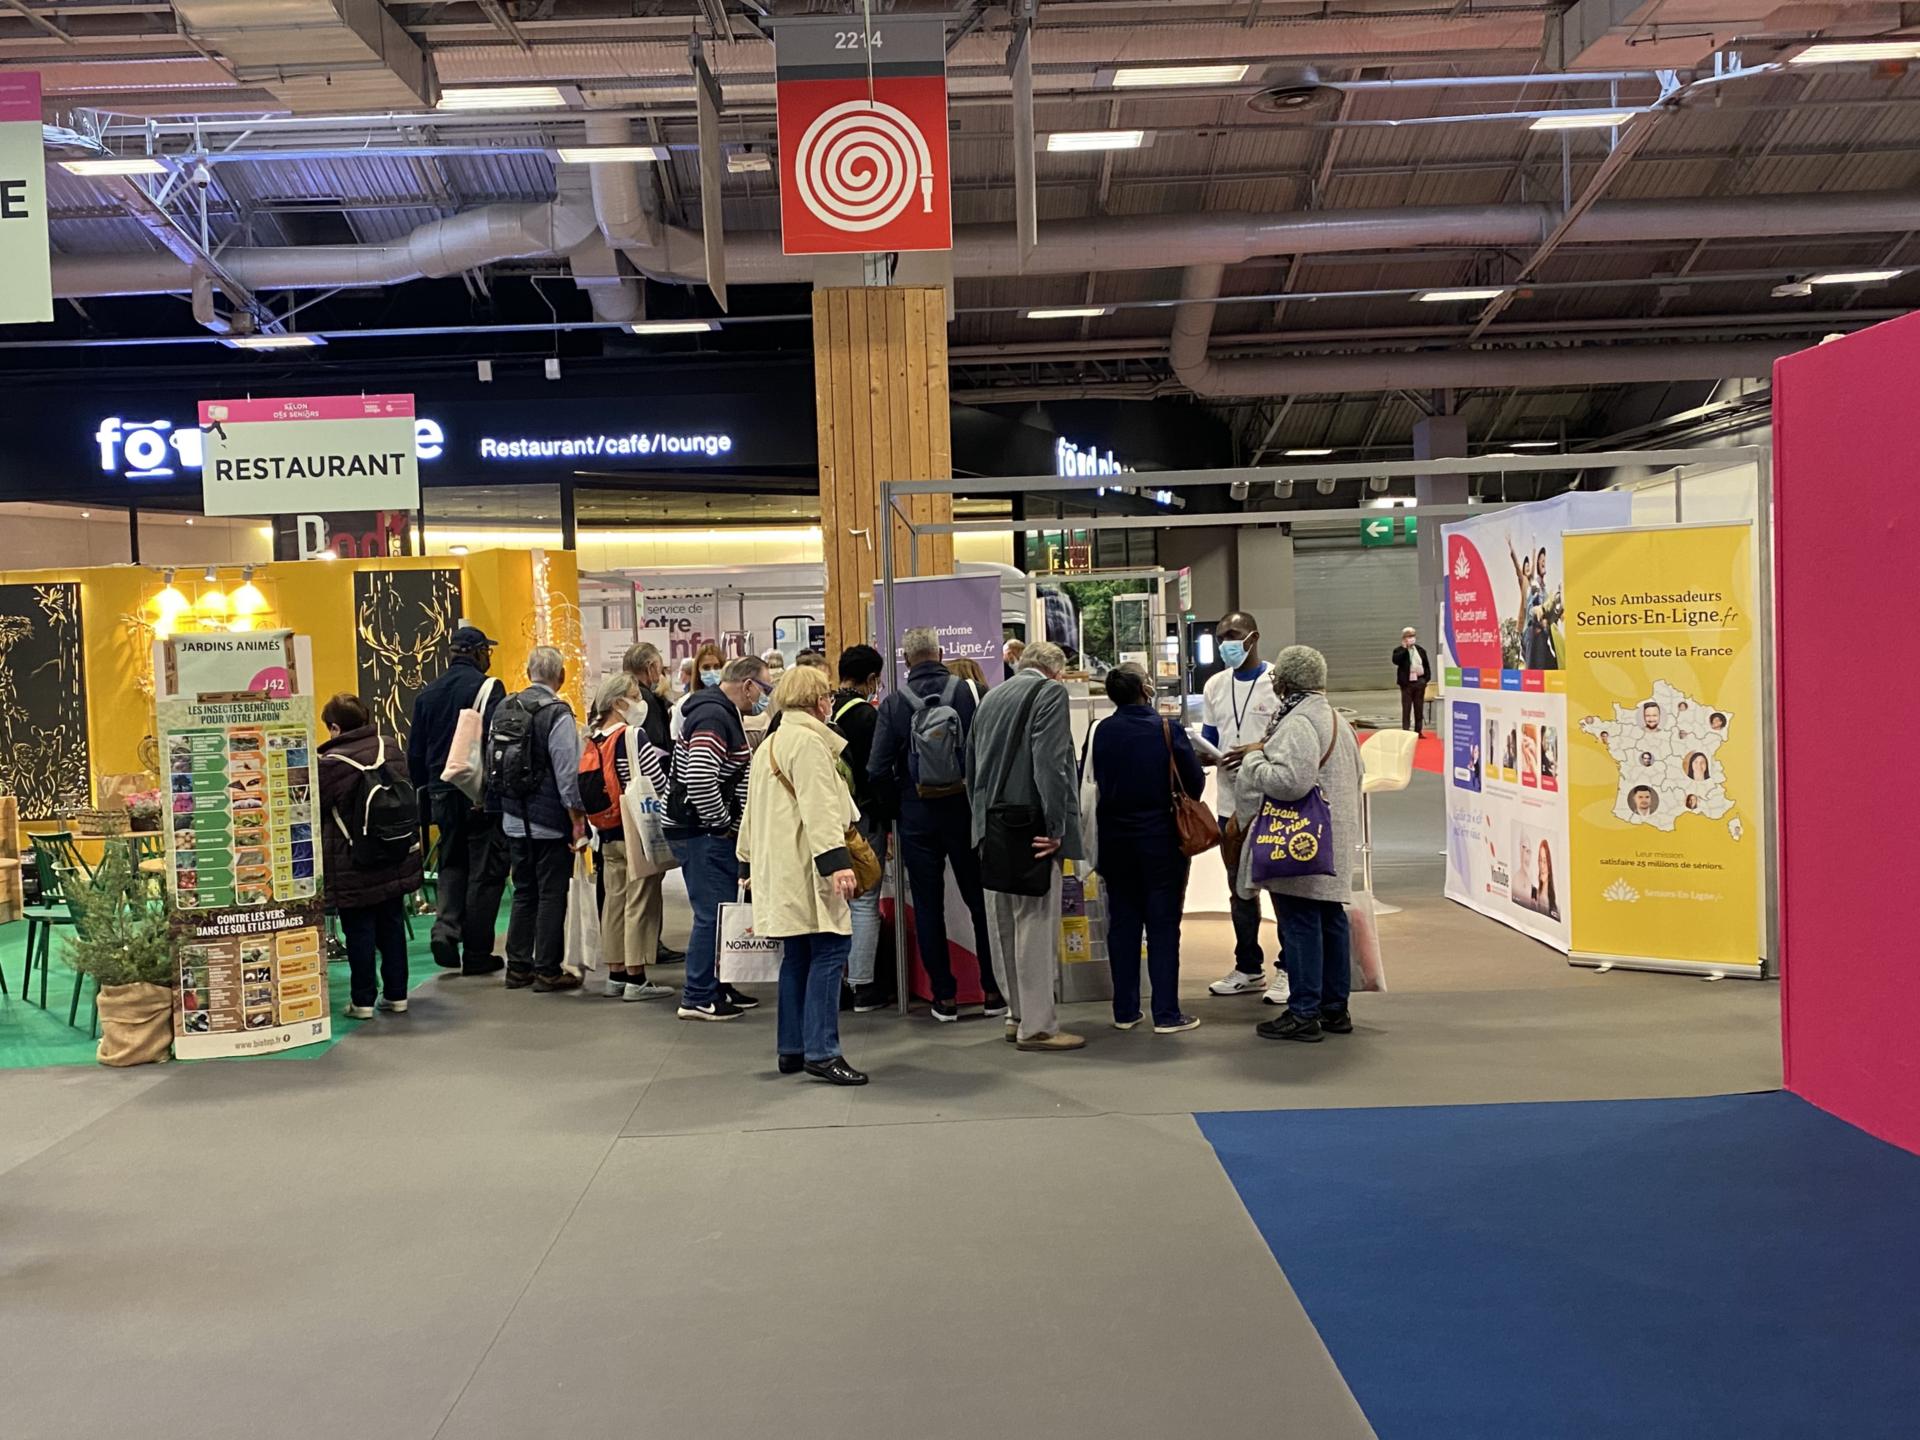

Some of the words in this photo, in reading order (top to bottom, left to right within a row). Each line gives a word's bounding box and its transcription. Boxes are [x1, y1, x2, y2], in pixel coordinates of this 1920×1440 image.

[834, 31, 883, 49] 2214
[480, 434, 732, 459] Restaurant/café/lounge
[215, 453, 406, 481] RESTAURANT
[1592, 595, 1616, 606] Nos
[1621, 591, 1722, 605] Ambassadeurs
[647, 603, 686, 615] service
[688, 603, 703, 614] de
[1577, 607, 1738, 627] Seniors-En-Ligne.fr
[181, 642, 233, 652] JARDINS
[236, 639, 281, 651] ANIMÉS
[1584, 647, 1636, 658] couvrent
[1639, 646, 1671, 657] toute
[1676, 646, 1687, 657] la
[1690, 646, 1733, 656] France
[262, 679, 285, 690] J42
[188, 706, 202, 715] LES
[204, 704, 243, 714] INSECTES
[201, 714, 224, 724] POUR
[225, 713, 252, 723] VOTRE
[252, 712, 280, 722] JARDIN
[1600, 858, 1635, 866] satisfaire
[1648, 860, 1679, 868] millions
[217, 914, 250, 925] CONTRE
[251, 912, 265, 921] LES
[266, 909, 286, 919] VERS
[197, 926, 219, 936] DANS
[220, 926, 230, 934] LE
[230, 924, 247, 934] SOL
[247, 923, 257, 932] ET
[258, 920, 272, 931] LES
[272, 917, 304, 929] LIMACES
[726, 940, 781, 950] NORMANDY
